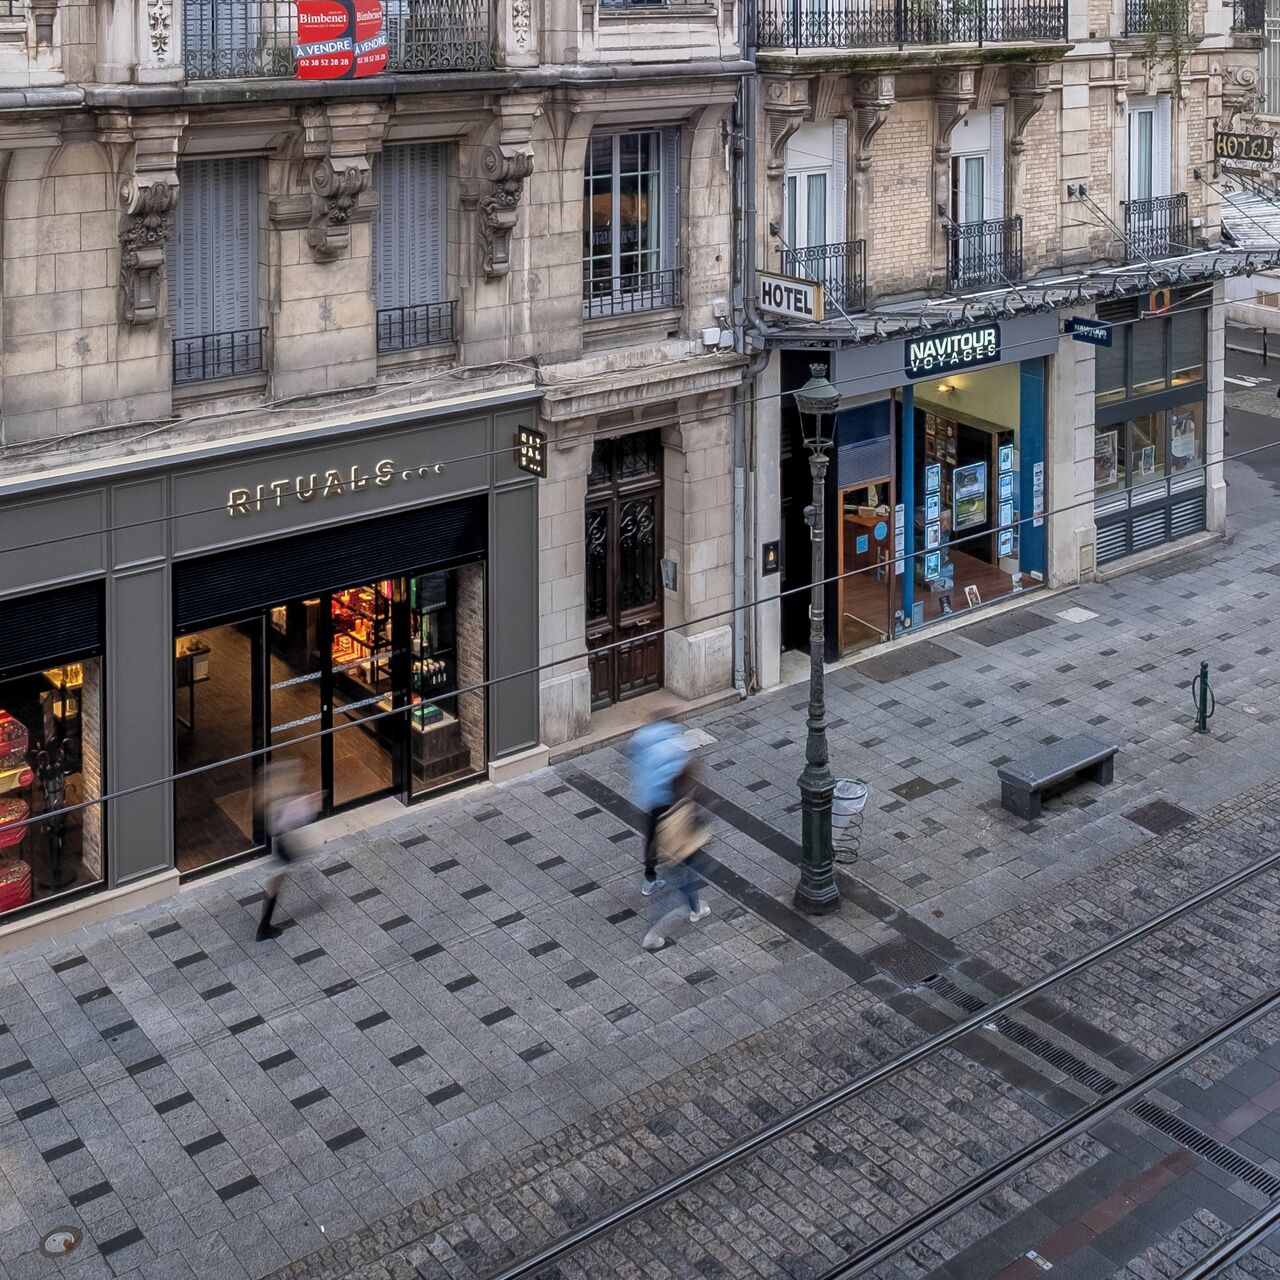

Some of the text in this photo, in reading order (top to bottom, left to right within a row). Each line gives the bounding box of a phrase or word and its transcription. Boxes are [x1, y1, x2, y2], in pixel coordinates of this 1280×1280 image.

[300, 13, 347, 24] Bimbenet
[297, 40, 351, 57] À VENDRE
[361, 36, 387, 52] VENDRE
[300, 59, 310, 67] 02
[340, 58, 349, 66] 28
[1217, 135, 1272, 160] HOTEL
[762, 281, 813, 316] HOTEL
[910, 328, 996, 361] NAVITOUR
[910, 344, 996, 372] VOYAGES
